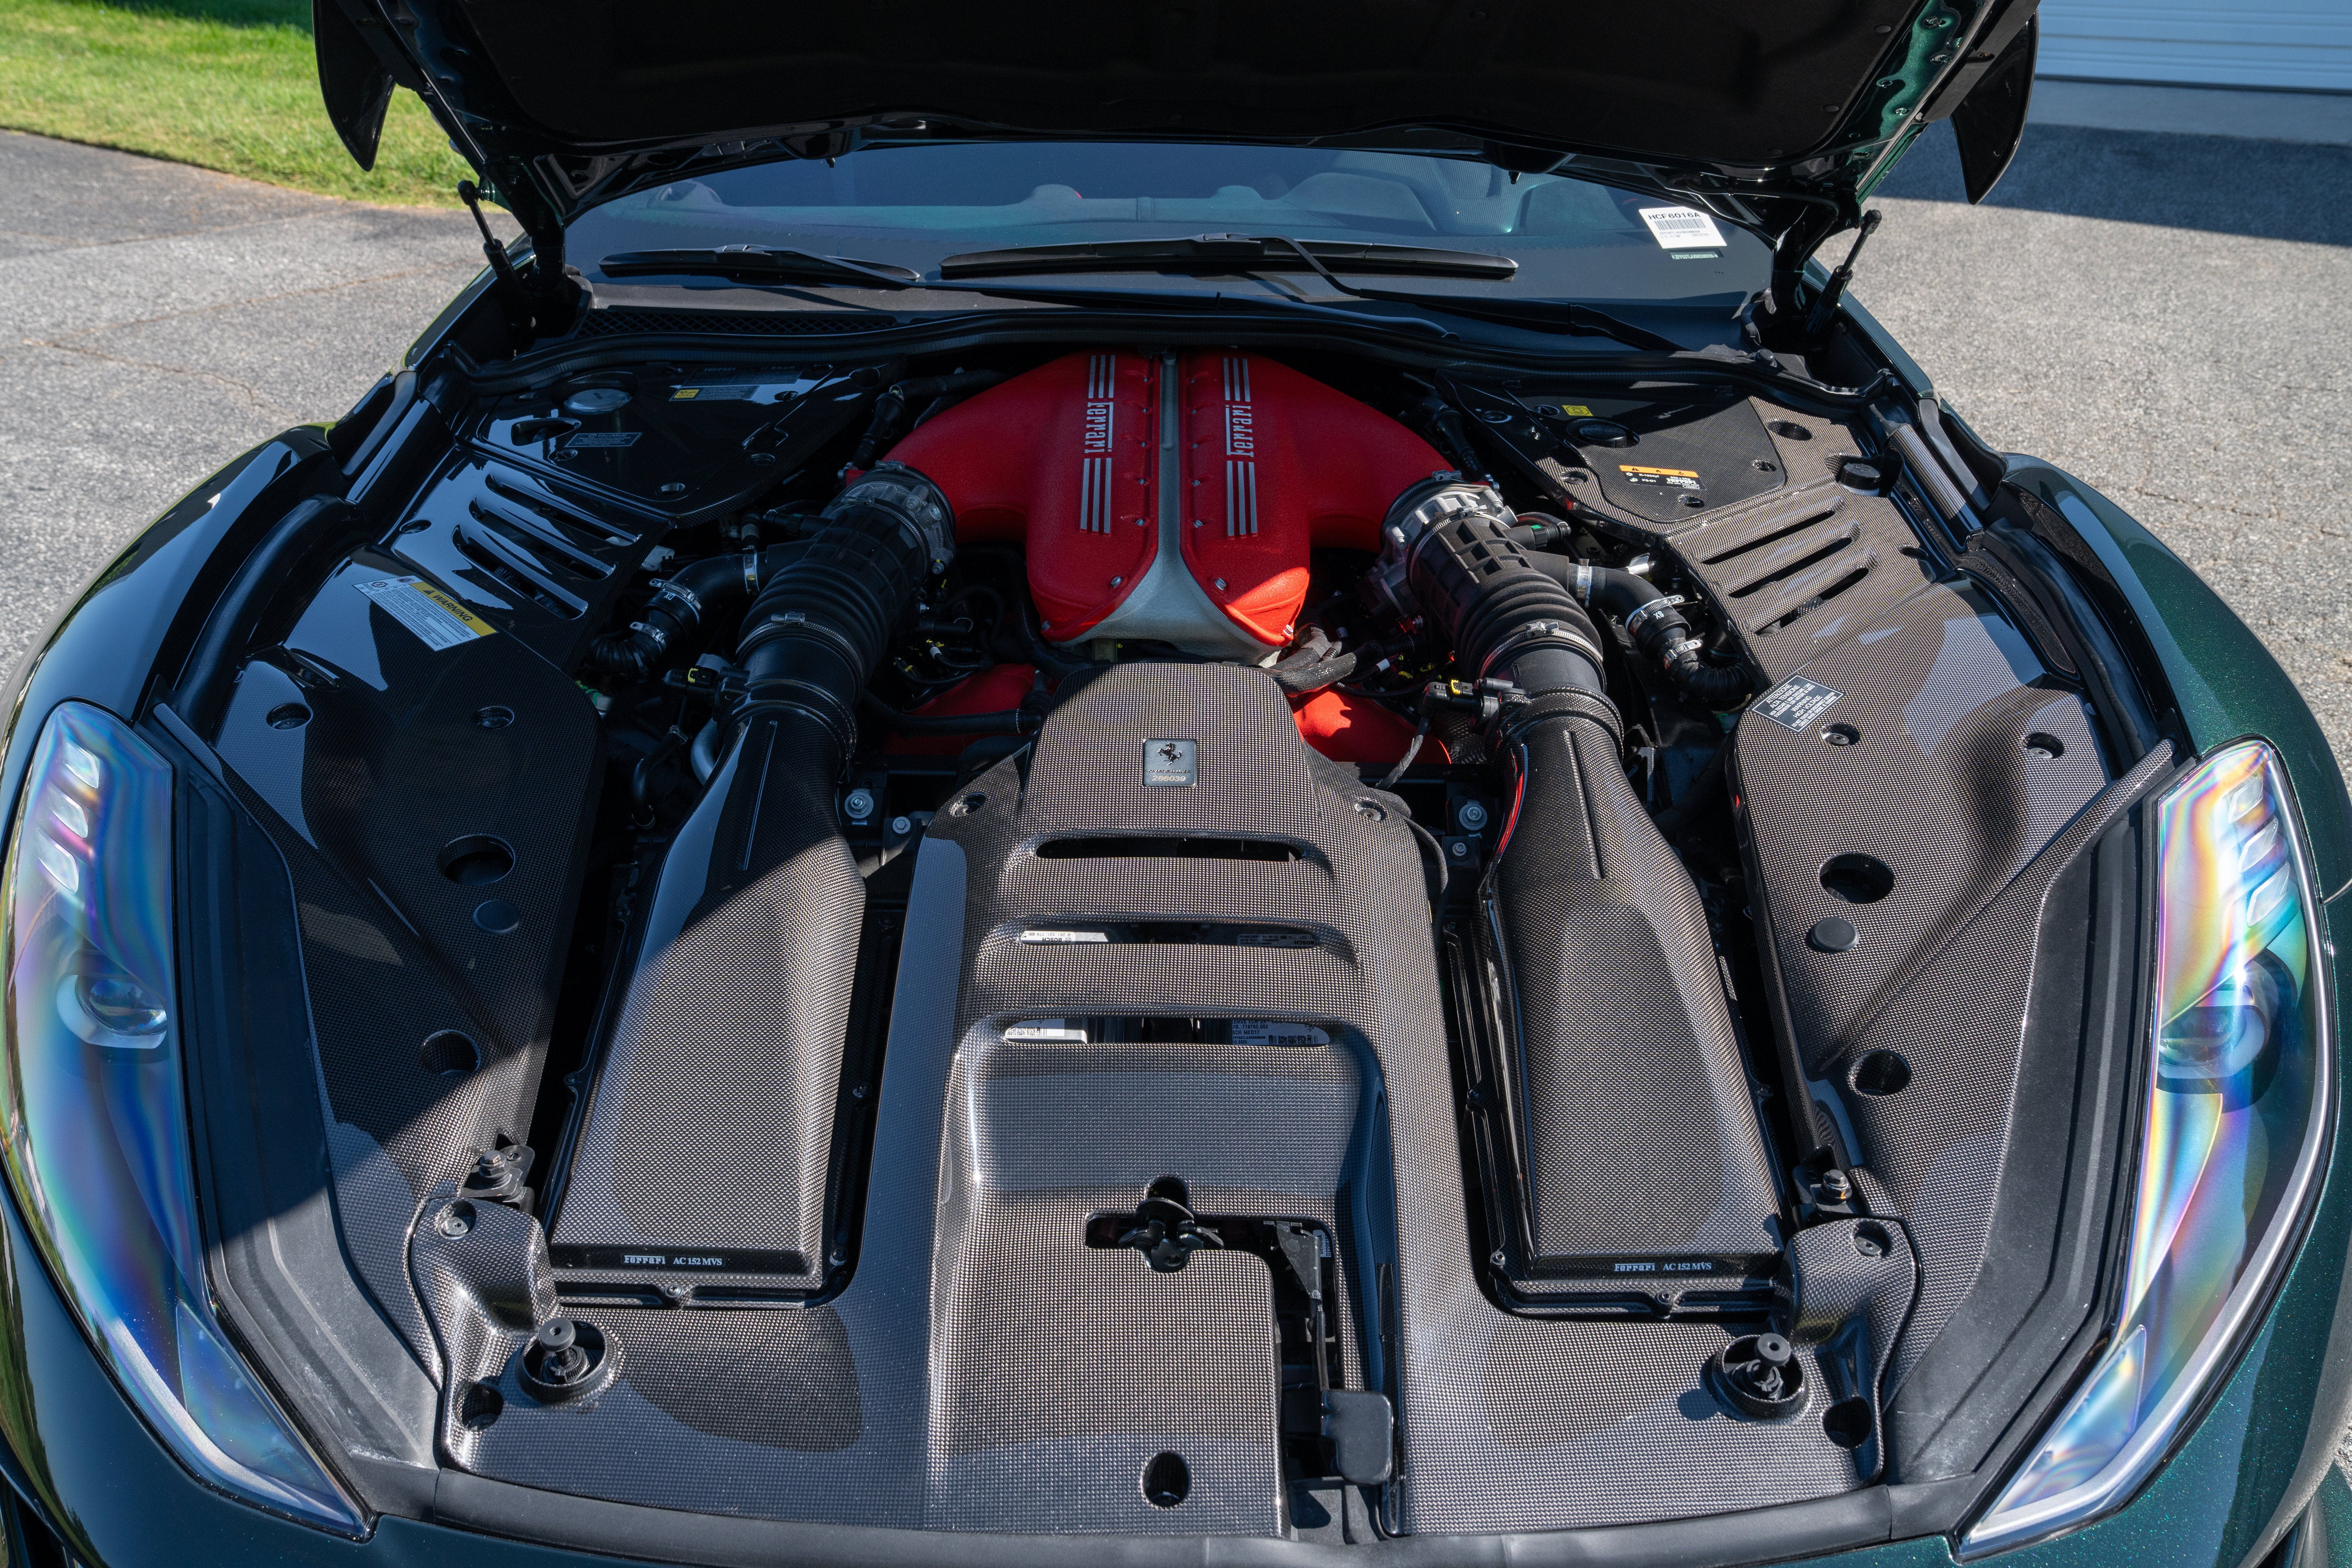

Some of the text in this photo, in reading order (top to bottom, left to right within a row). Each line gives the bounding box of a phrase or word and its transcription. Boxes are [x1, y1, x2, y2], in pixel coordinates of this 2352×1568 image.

[1084, 402, 1113, 453] Ferrari
[1225, 405, 1254, 457] Ferrari
[432, 595, 473, 622] WARNING
[1766, 684, 1792, 704] ATTENZIONE
[1768, 684, 1801, 708] ALTA TENSIONE
[1791, 695, 1812, 711] WARNING
[1794, 692, 1806, 701] MOTORE
[1775, 702, 1787, 711] TOCCARE
[1793, 695, 1823, 718] HIGH VOLTAGE
[624, 1255, 665, 1264] Ferrari
[1614, 1263, 1655, 1271] Ferrari
